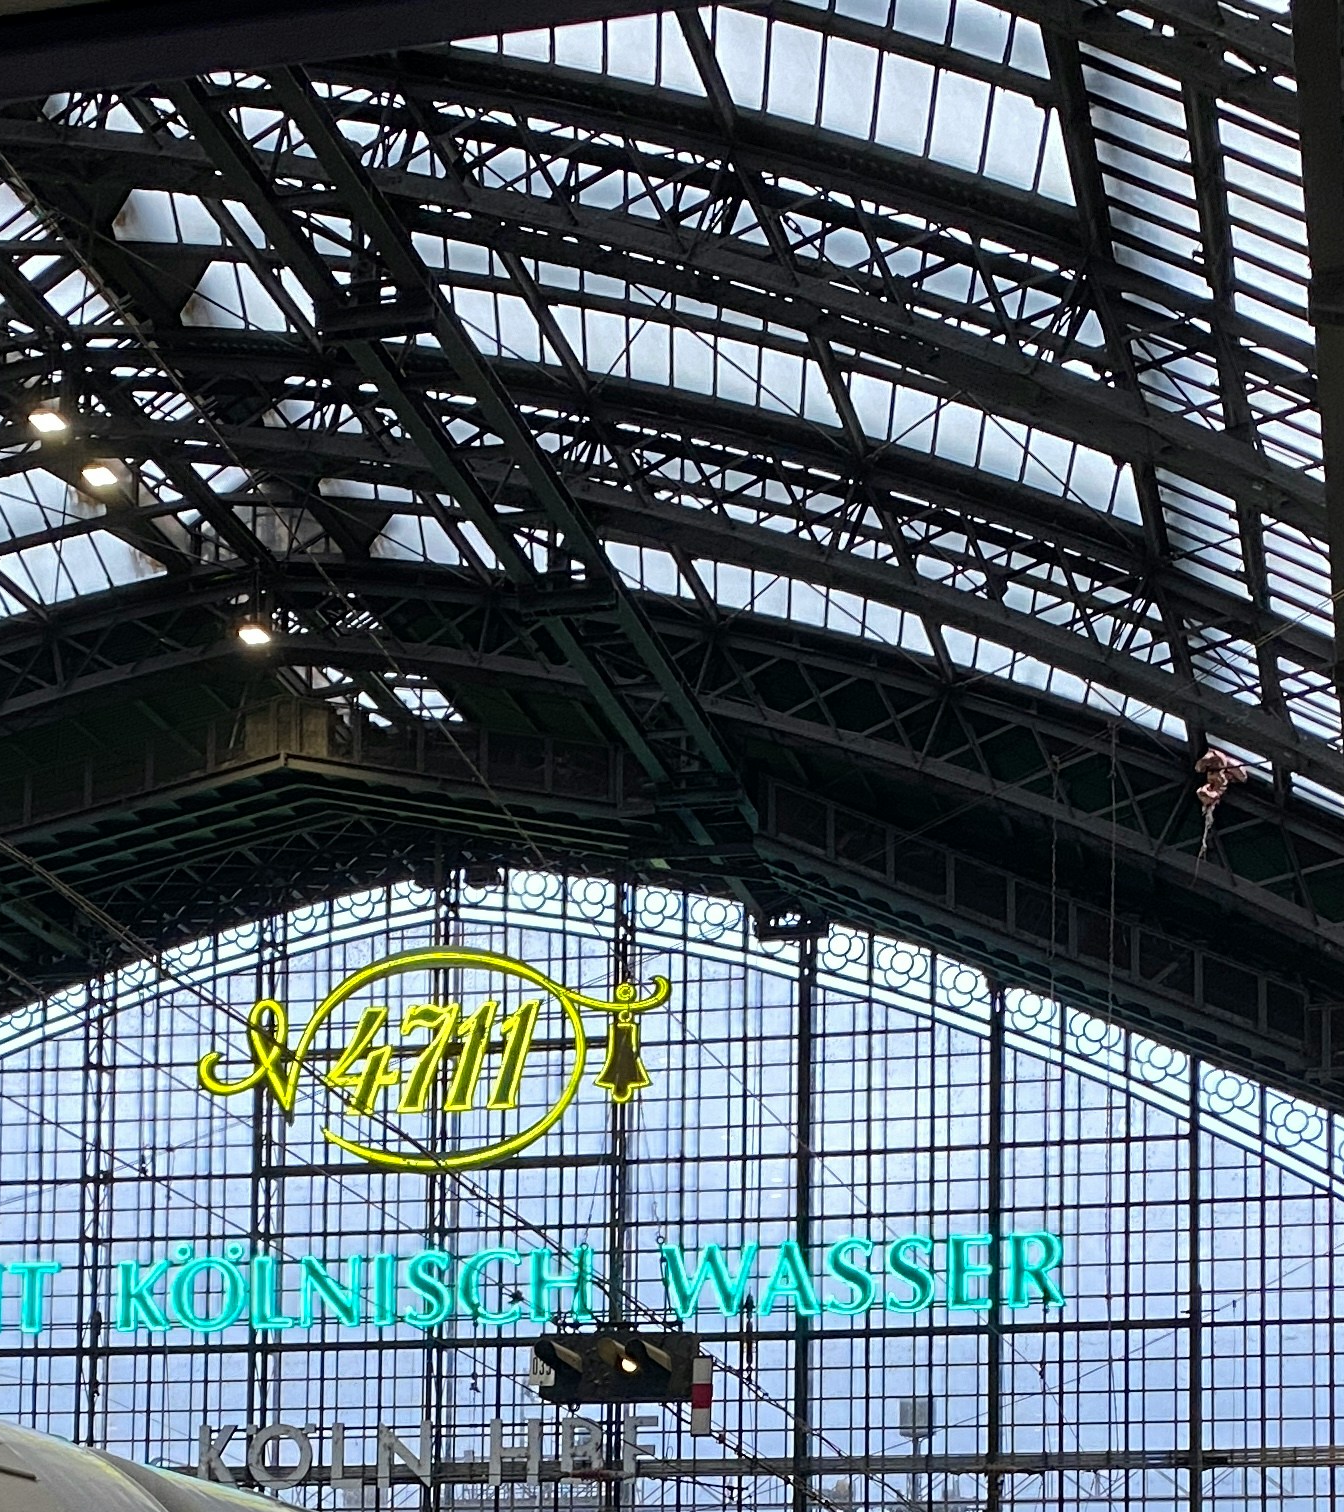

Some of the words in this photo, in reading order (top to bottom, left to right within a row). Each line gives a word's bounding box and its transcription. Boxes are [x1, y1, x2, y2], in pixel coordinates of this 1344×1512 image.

[325, 998, 544, 1115] 4711
[116, 1243, 596, 1333] KÖLNISCH
[660, 1231, 1066, 1318] WASSER
[196, 1420, 434, 1491] KÖLN
[488, 1415, 659, 1487] HBF
